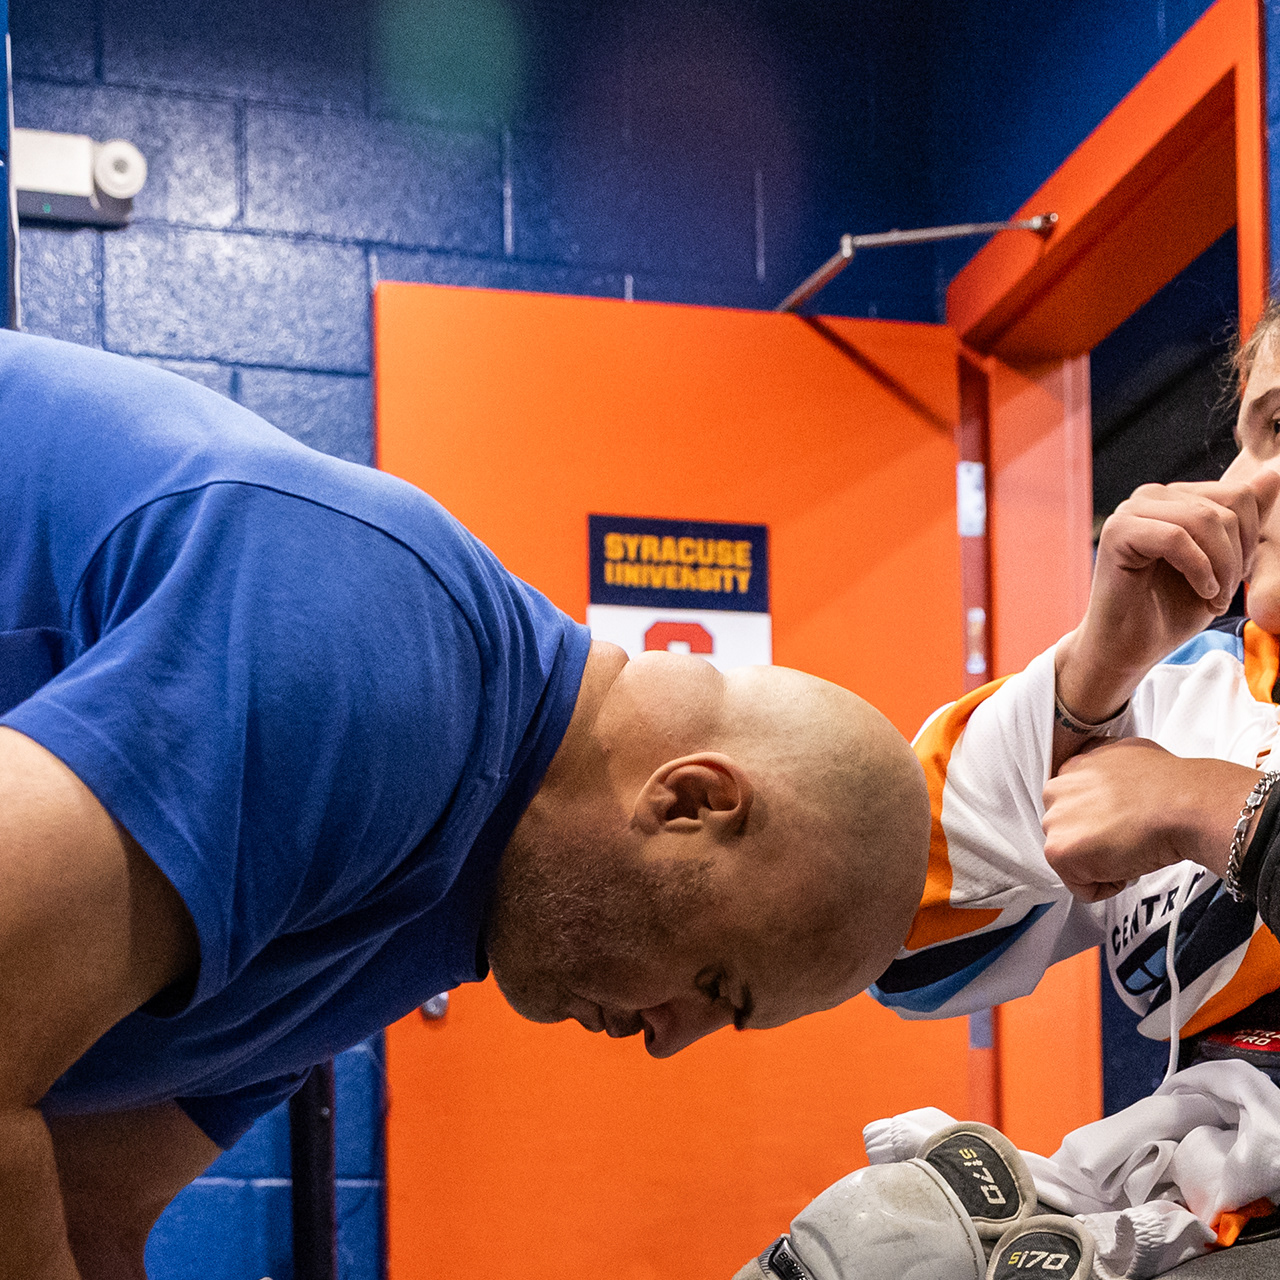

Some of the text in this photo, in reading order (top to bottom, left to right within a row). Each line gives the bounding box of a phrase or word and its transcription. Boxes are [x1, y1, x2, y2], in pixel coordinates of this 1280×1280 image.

[604, 532, 752, 567] SYRACUSE
[604, 561, 752, 594] UNIVERSITY
[1007, 1250, 1070, 1271] S170
